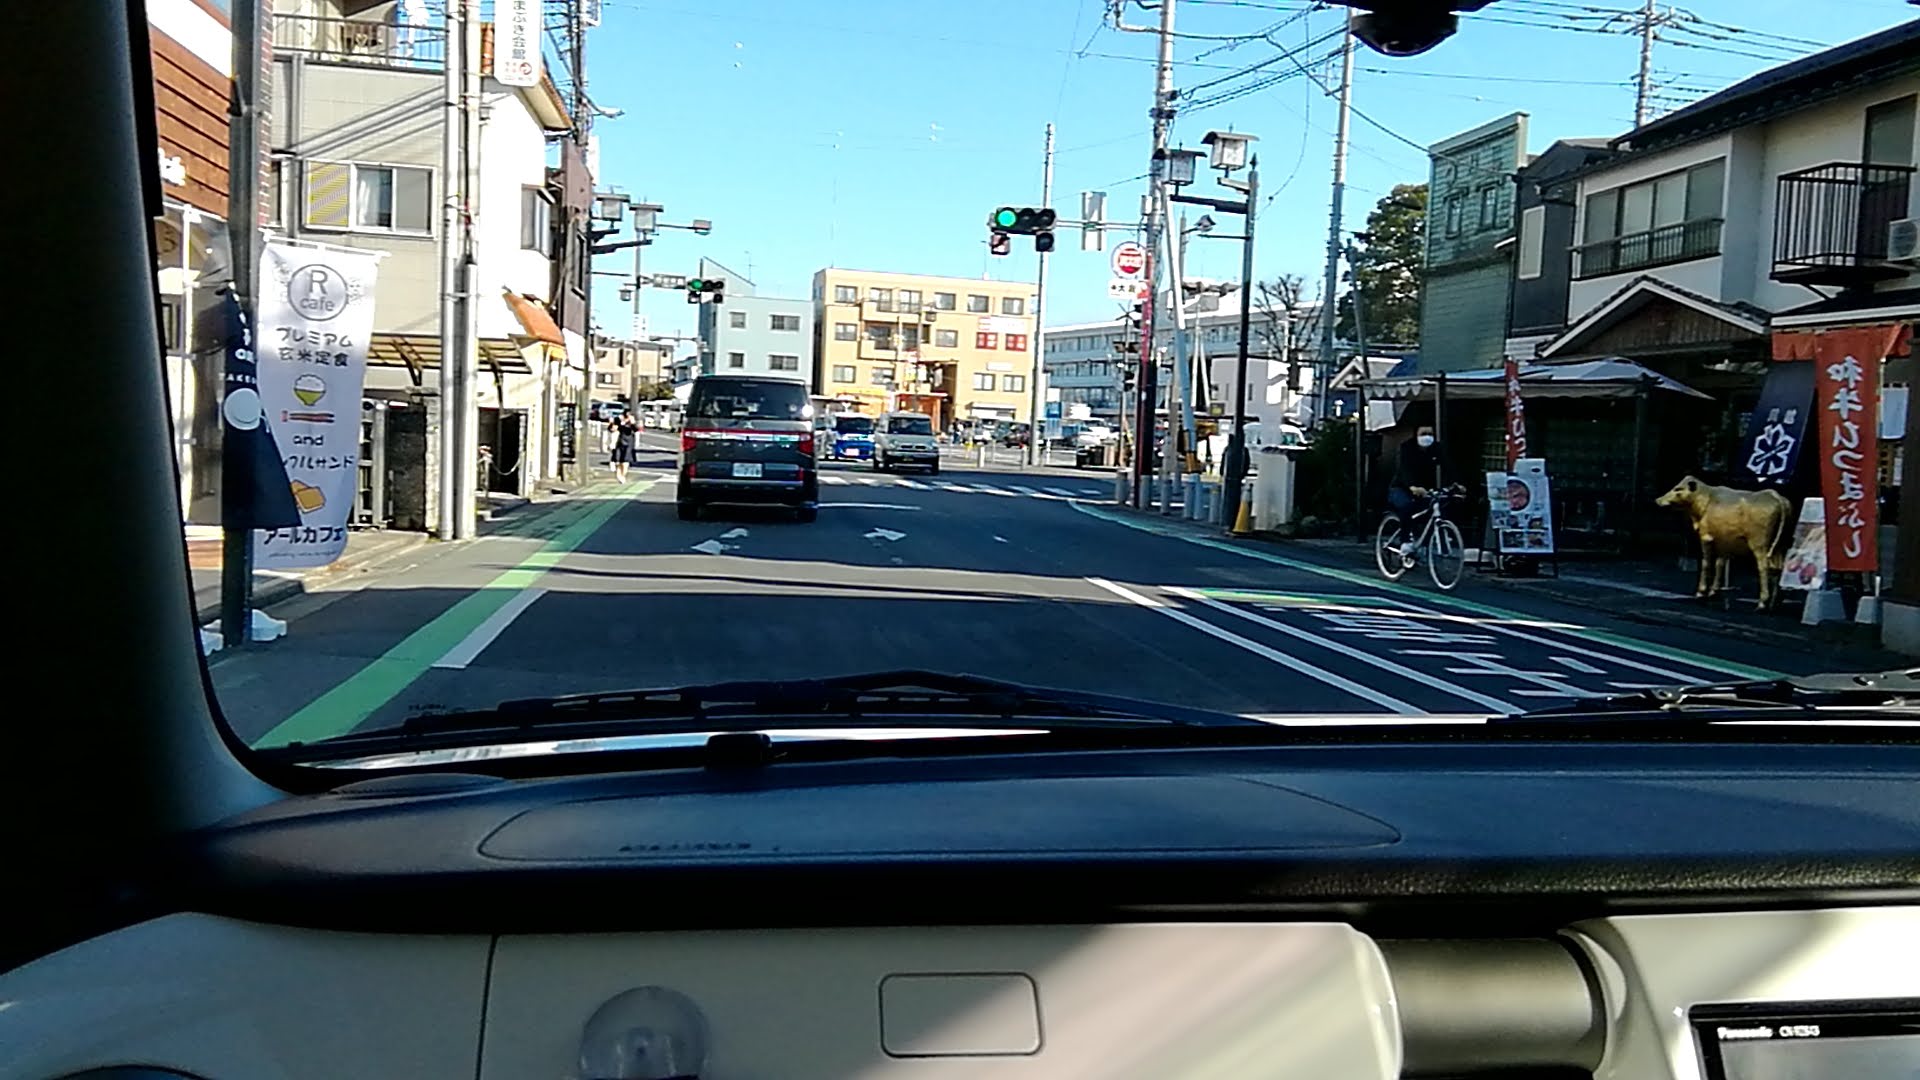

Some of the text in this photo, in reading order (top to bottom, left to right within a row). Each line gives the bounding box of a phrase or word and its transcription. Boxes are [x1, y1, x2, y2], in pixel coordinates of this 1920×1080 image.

[309, 269, 328, 295] R
[300, 297, 335, 311] cafe
[276, 326, 353, 347] プレミアム
[278, 347, 349, 366] 玄米定食
[293, 435, 324, 446] and
[264, 526, 344, 545] アールカフェ
